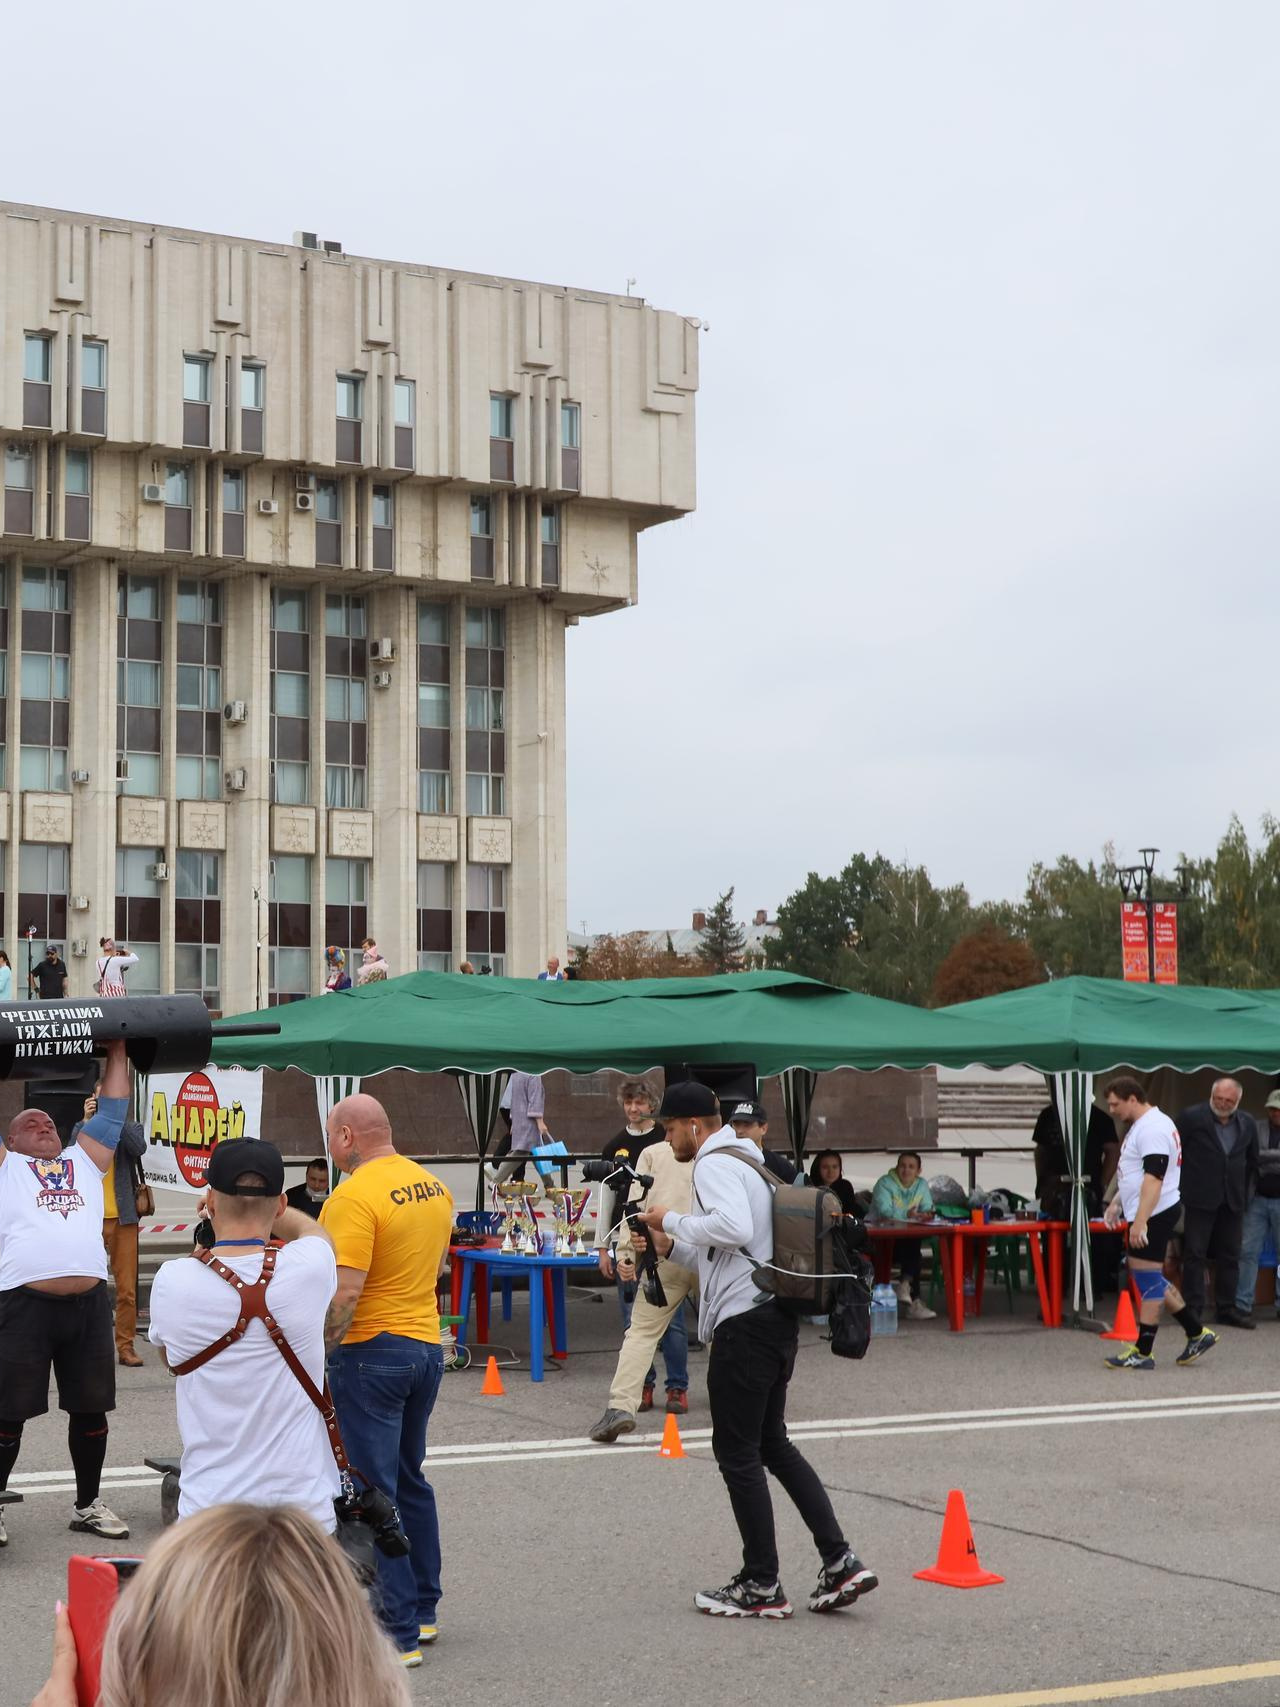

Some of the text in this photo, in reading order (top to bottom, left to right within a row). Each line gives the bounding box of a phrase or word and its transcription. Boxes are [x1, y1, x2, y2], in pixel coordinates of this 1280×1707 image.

[1, 1007, 104, 1022] ФЕДЕРАЦИЯ
[16, 1020, 92, 1039] ТЯЖЁЛОЙ
[15, 1040, 93, 1057] АТЛЕТИКИ
[145, 1171, 168, 1183] олдина
[390, 1182, 445, 1205] СУДЬЯ
